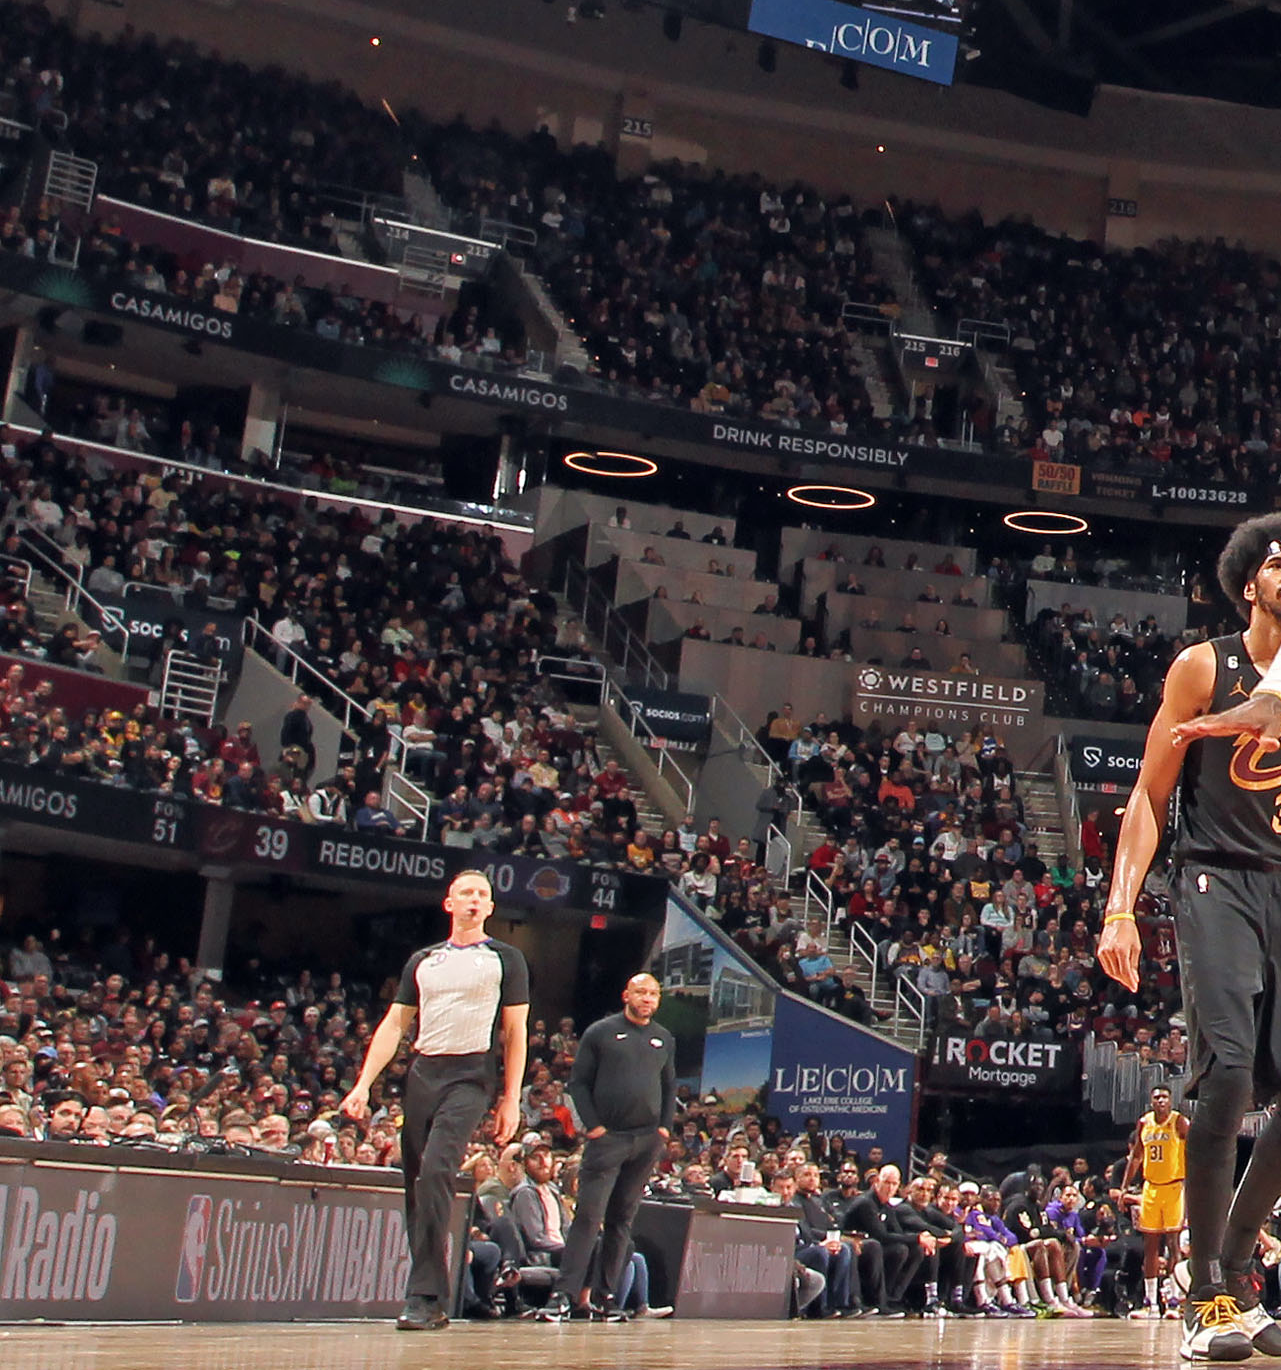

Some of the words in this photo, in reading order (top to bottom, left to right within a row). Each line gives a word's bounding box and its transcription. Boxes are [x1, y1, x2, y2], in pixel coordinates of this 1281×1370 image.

[623, 119, 653, 135] 215
[111, 291, 233, 339] CASAMIGOS
[904, 340, 926, 353] 215
[939, 344, 961, 357] 216
[450, 375, 568, 411] CASAMIGOS
[713, 424, 772, 448] DRINK
[778, 436, 909, 466] RESPONSIBLY
[1038, 464, 1076, 479] 50/50
[1152, 485, 1248, 503] L-10033628
[1227, 656, 1238, 669] 6
[888, 674, 1026, 702] WESTFIELD
[646, 708, 705, 723] SOCIOS.com
[860, 701, 969, 721] CHAMPIONS
[980, 712, 1025, 726] CLUB
[153, 820, 177, 844] 51
[254, 826, 288, 860] 39
[320, 841, 445, 879] REBOUNDS
[483, 864, 514, 892] 40
[592, 889, 615, 909] 44
[947, 1037, 1061, 1068] ROCKET
[969, 1066, 1036, 1087] Mortgage
[789, 1105, 800, 1113] OF
[801, 1105, 849, 1113] OSTEOPATHIC
[851, 1106, 888, 1114] MEDICINE
[803, 1096, 828, 1104] LAKE
[830, 1097, 848, 1105] ERIE
[840, 1097, 873, 1105] COLLEGE
[1150, 1146, 1163, 1162] 31
[2, 1186, 117, 1300] Radio
[208, 1199, 329, 1302] SiriusXM
[323, 1206, 382, 1302] NBA
